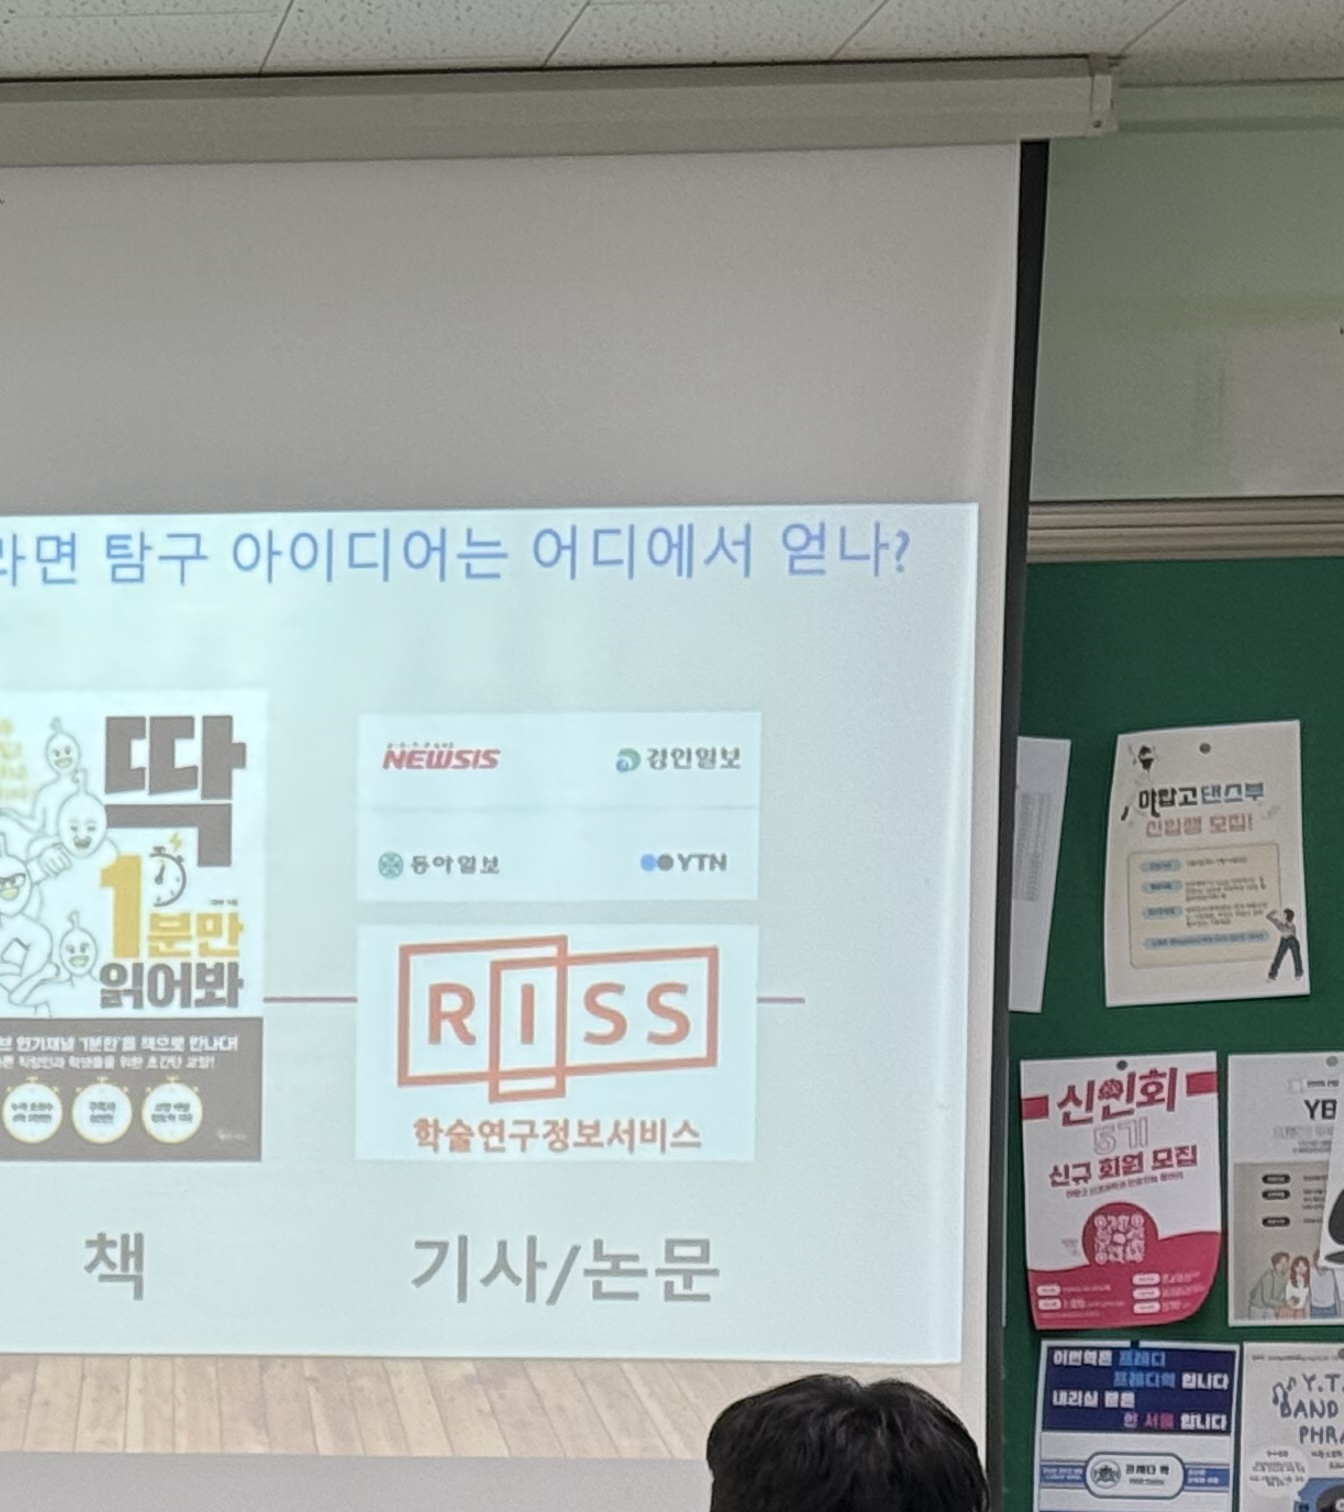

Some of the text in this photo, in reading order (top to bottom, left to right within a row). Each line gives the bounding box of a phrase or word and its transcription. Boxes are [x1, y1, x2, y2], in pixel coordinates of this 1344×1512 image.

[105, 528, 209, 587] 탐구
[231, 524, 510, 584] 아이디어는
[532, 521, 754, 581] 어디에서
[780, 519, 912, 577] 얻나?
[381, 747, 502, 771] NEWSIS
[646, 746, 742, 772] 경인일보
[104, 714, 247, 868] 딱
[410, 853, 502, 876] 동아일보
[676, 852, 728, 873] YTN
[426, 981, 692, 1047] RISS
[412, 1116, 703, 1155] 학술연구정보서비스
[1048, 1161, 1092, 1188] 신규
[1097, 1151, 1145, 1181] 회원
[1151, 1144, 1198, 1171] 모집
[83, 1231, 145, 1301] 책
[410, 1233, 721, 1306] 기사/논문
[1181, 1371, 1230, 1390] 입니다
[1280, 1399, 1339, 1420] BAND
